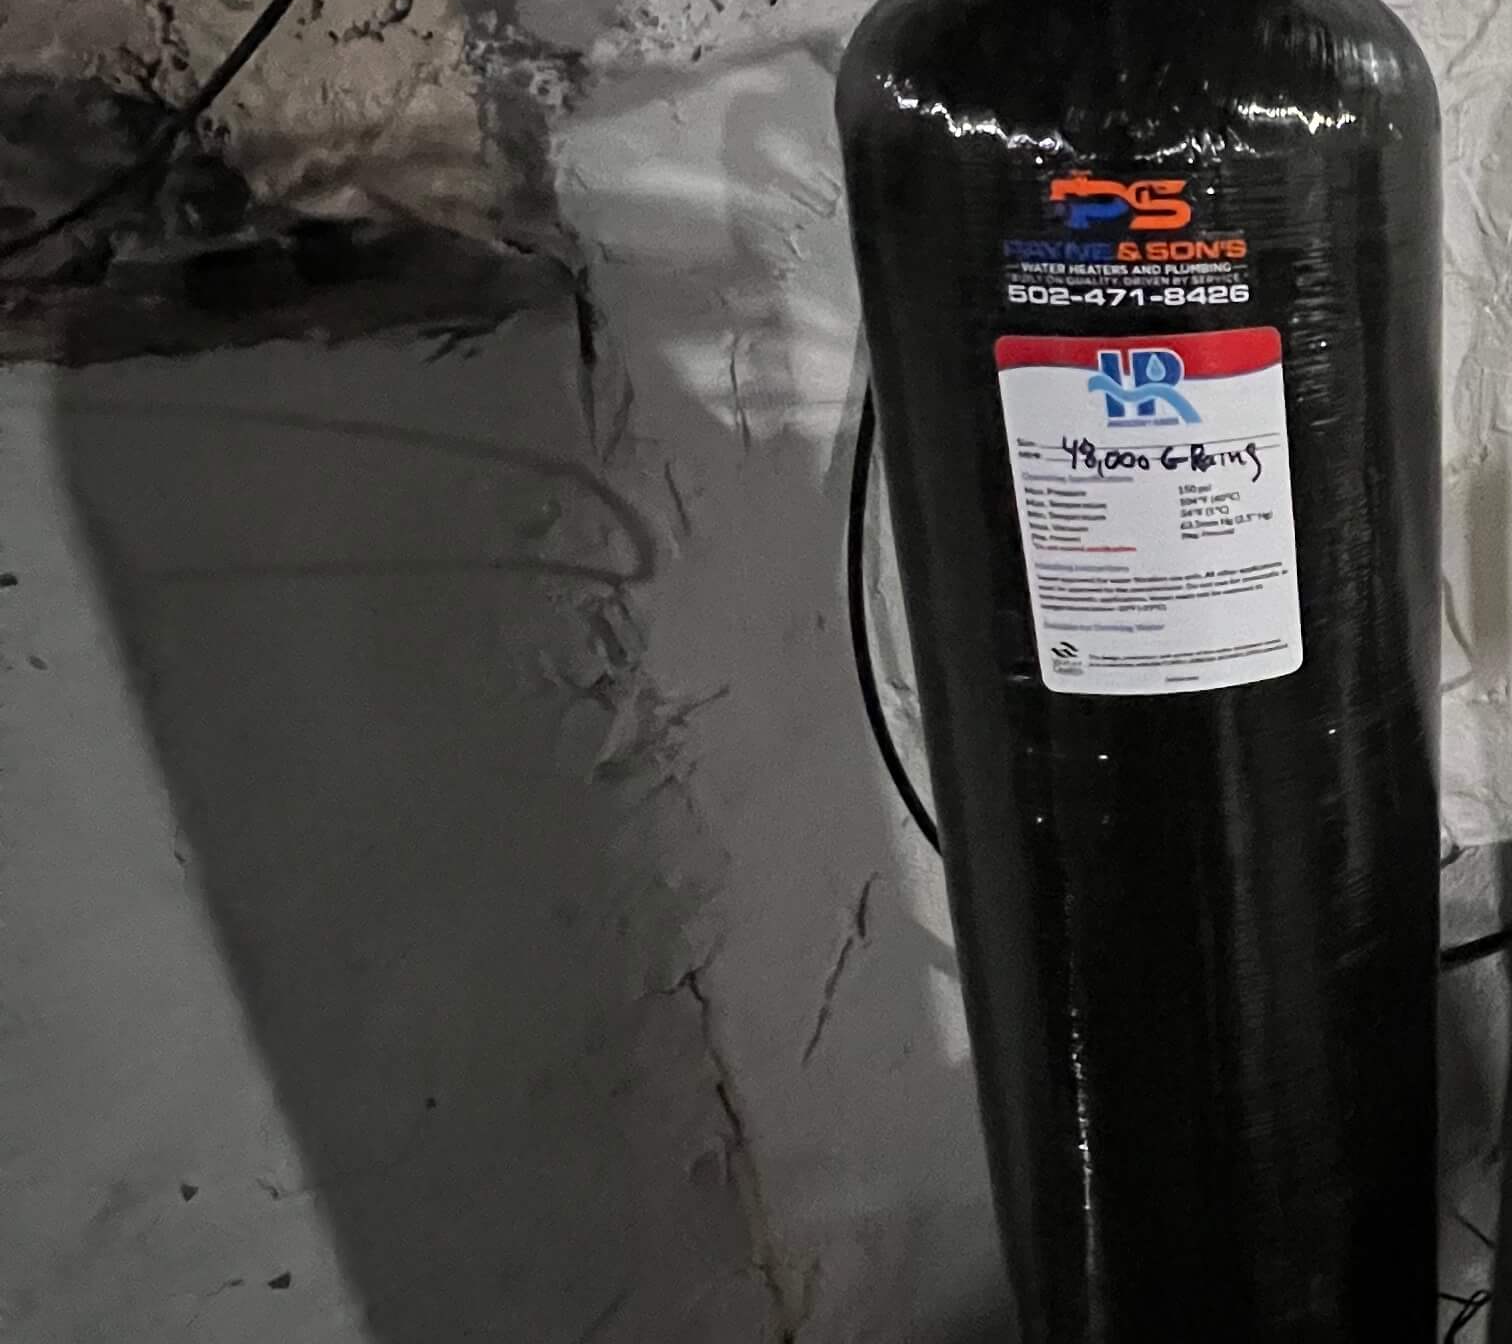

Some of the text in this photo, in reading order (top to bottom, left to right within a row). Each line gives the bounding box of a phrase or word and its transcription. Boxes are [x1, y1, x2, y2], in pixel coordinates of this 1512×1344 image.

[1116, 240, 1142, 262] &
[1145, 239, 1248, 261] SON'S
[1020, 261, 1232, 276] WATER HEATERS AND PLUMBING
[1007, 283, 1250, 307] 502-471-8426
[1062, 436, 1149, 479] 48,000
